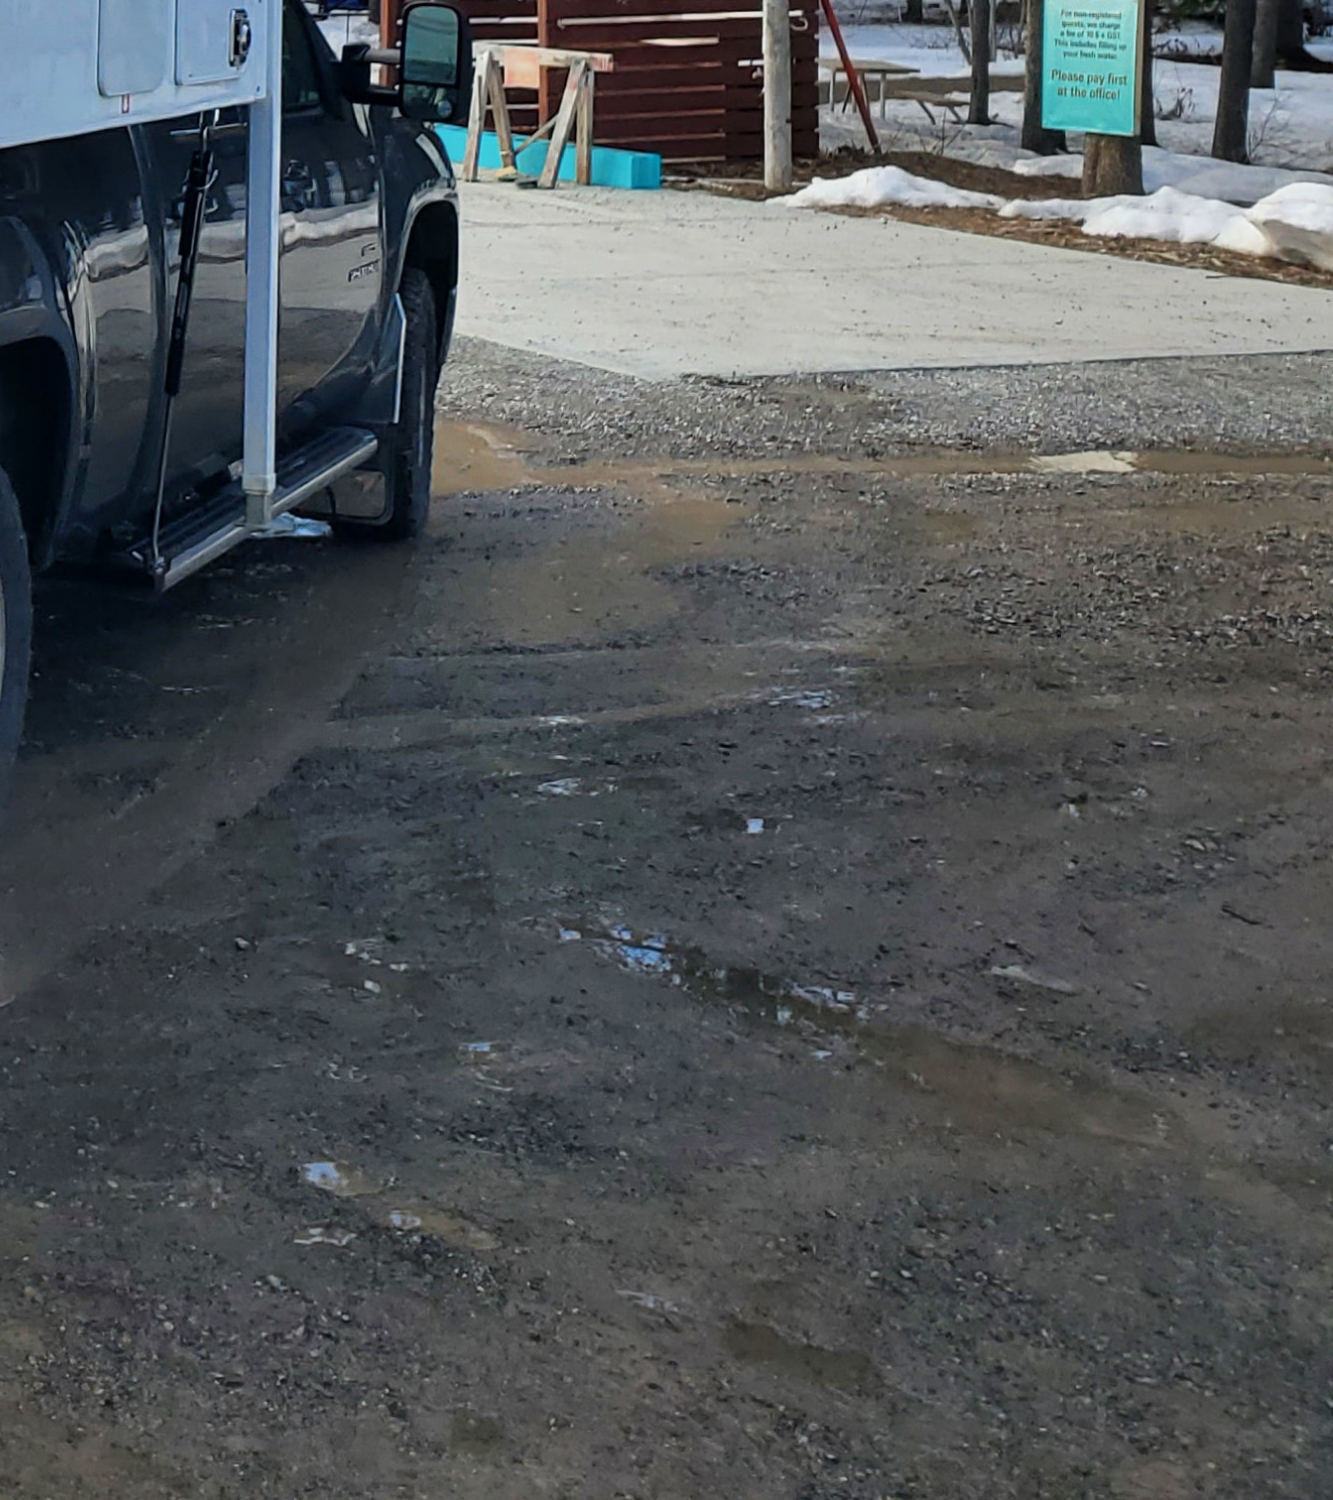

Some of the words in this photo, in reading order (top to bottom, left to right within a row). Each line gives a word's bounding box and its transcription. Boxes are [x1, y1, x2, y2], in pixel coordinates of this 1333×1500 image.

[1051, 69, 1084, 82] Please
[1087, 73, 1105, 86] pay
[1108, 72, 1127, 86] first
[1057, 87, 1067, 97] at
[1070, 86, 1086, 98] the
[1089, 88, 1121, 100] office!
